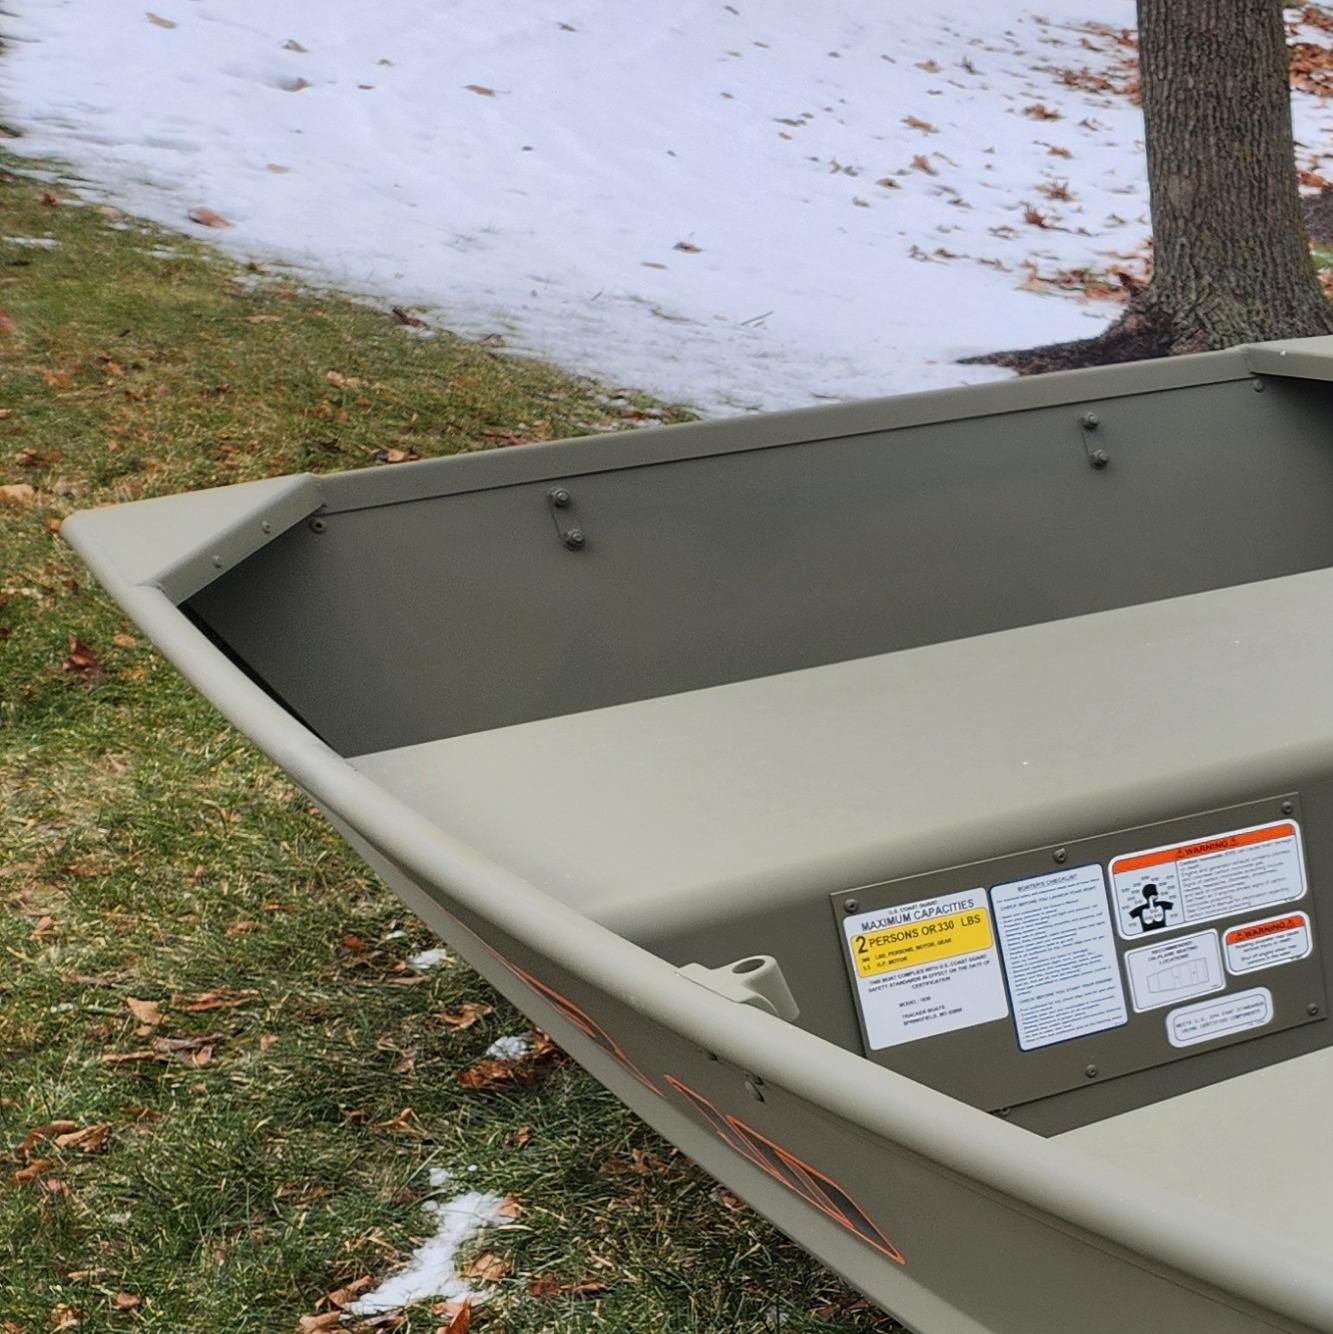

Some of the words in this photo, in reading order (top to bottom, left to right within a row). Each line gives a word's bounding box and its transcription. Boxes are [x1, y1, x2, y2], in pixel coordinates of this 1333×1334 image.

[1185, 841, 1228, 855] WARNING
[861, 912, 911, 932] MAXIMUM
[913, 898, 975, 920] CAPACITIES
[869, 928, 919, 948] PERSONS
[921, 924, 938, 936] OR
[938, 920, 955, 932] 330
[961, 914, 981, 927] LBS
[1245, 923, 1285, 937] WARNING
[855, 935, 868, 954] 2
